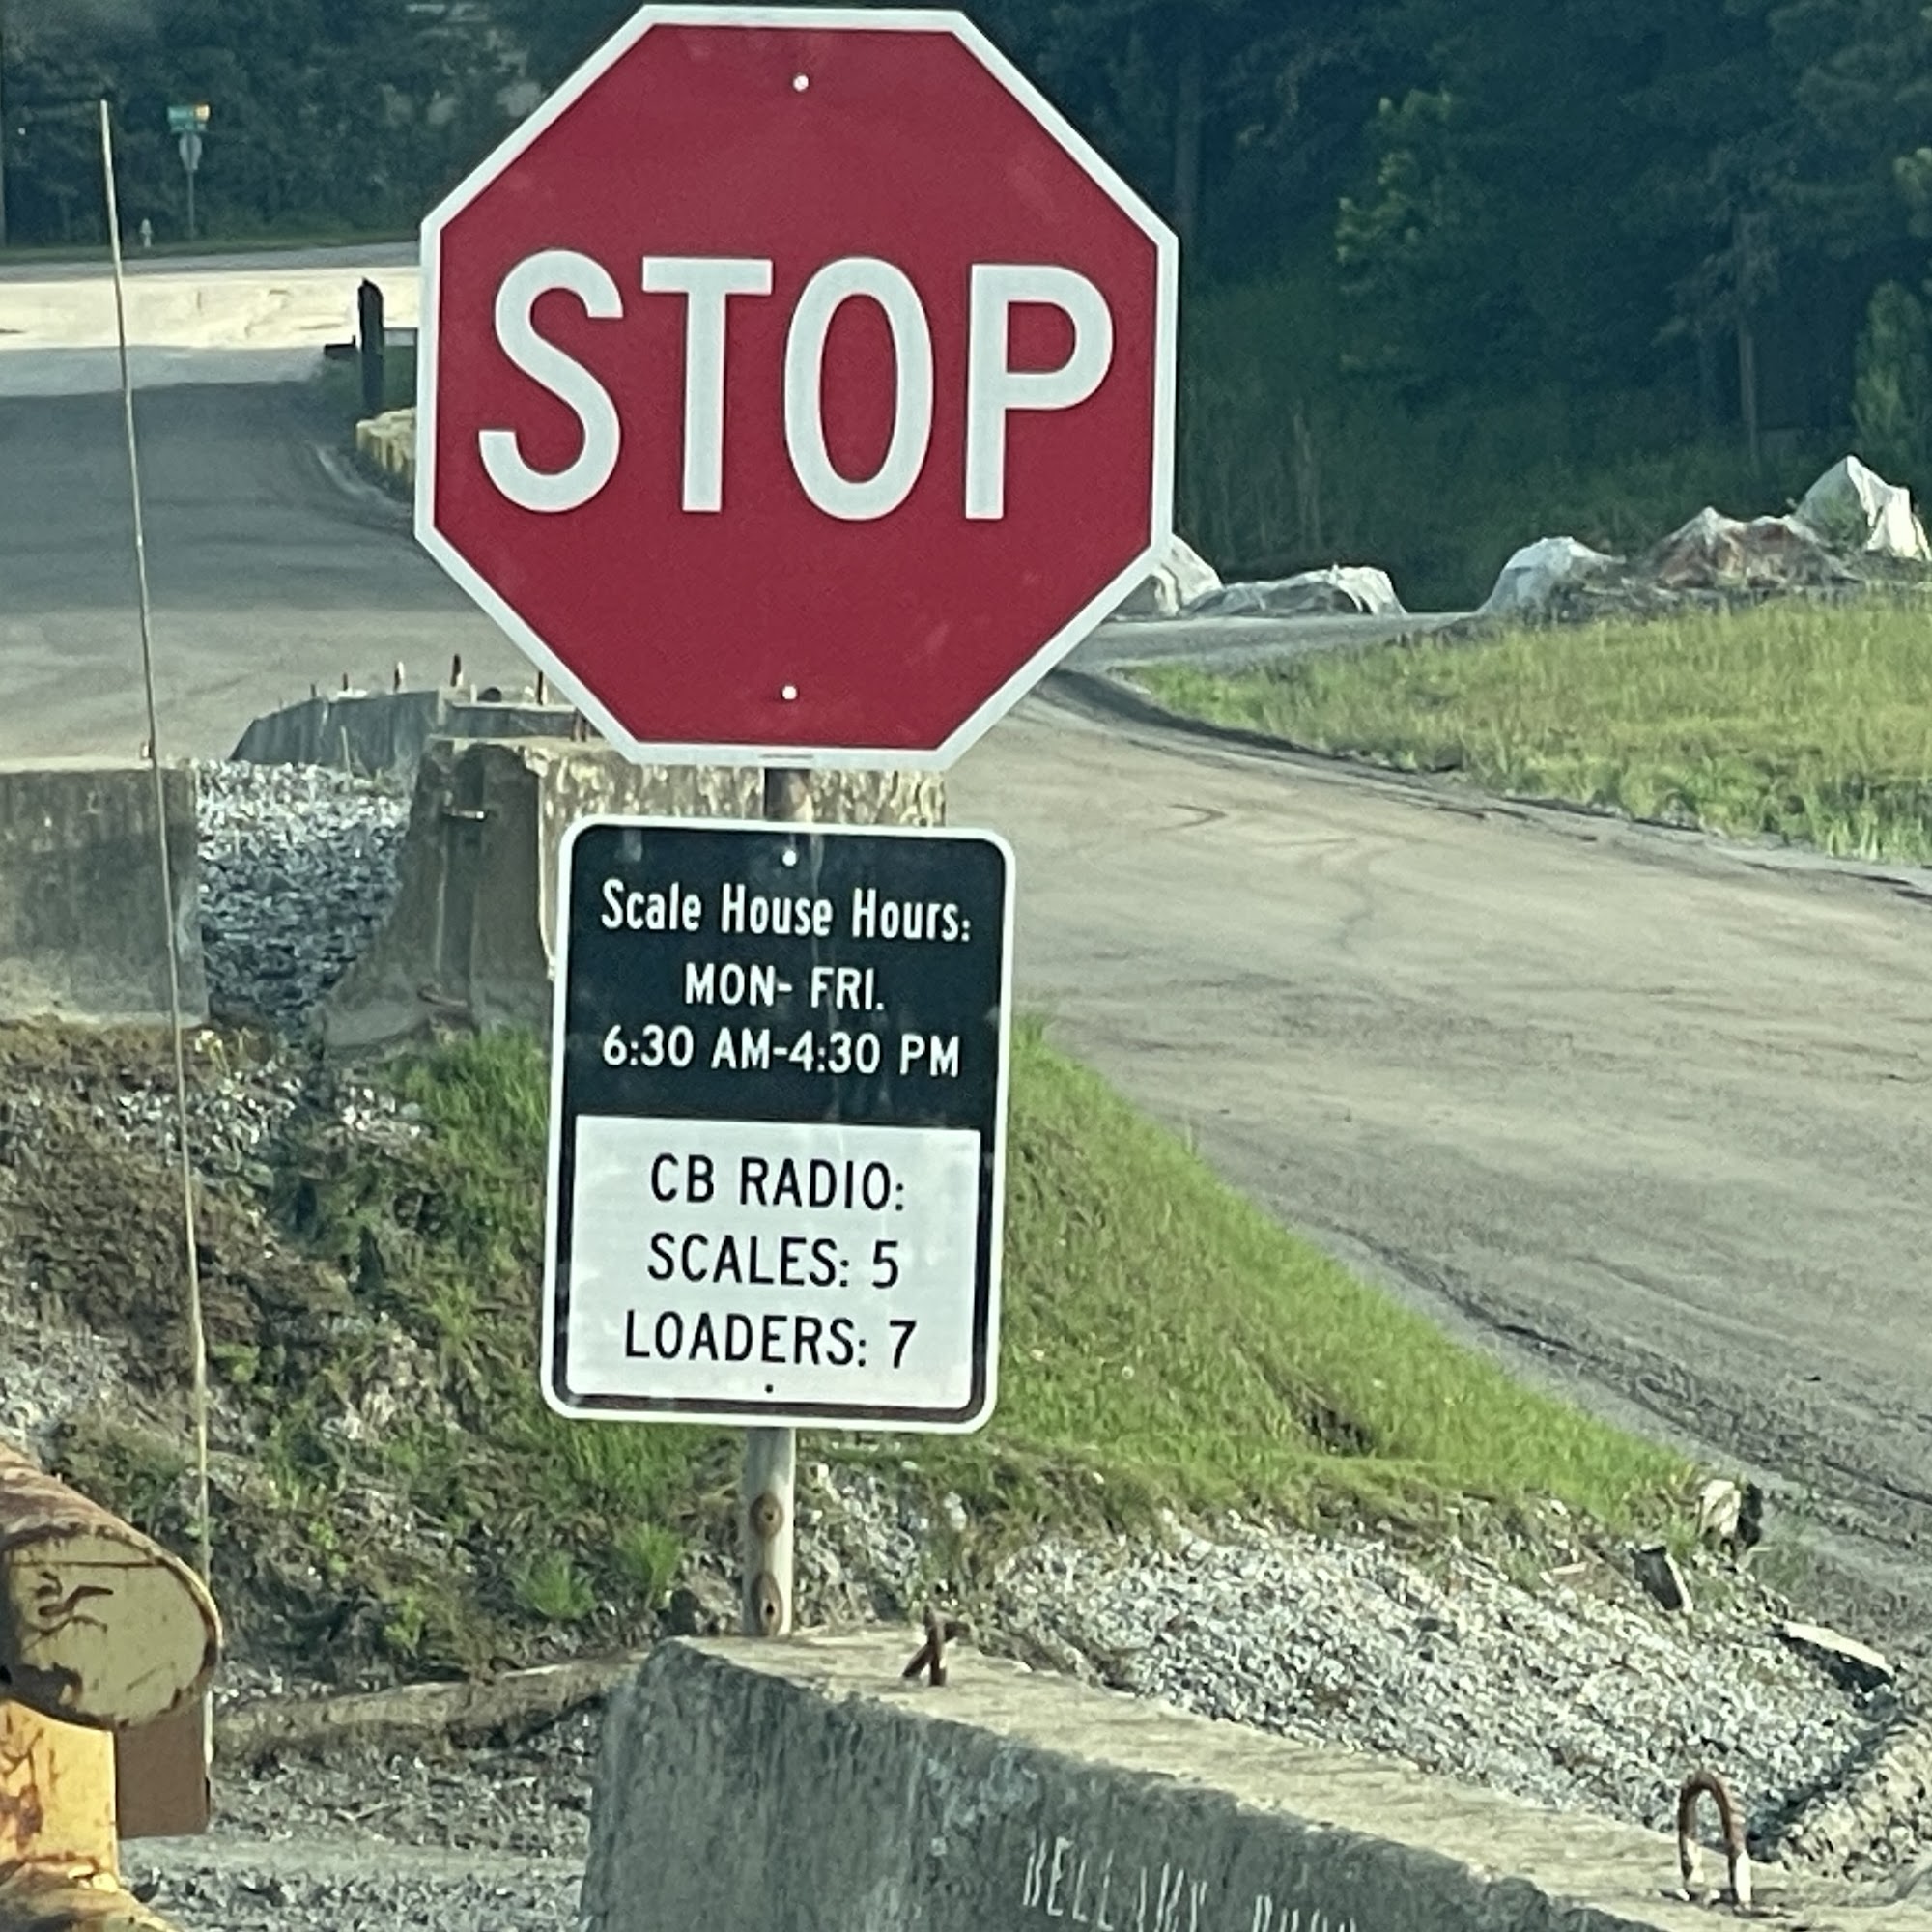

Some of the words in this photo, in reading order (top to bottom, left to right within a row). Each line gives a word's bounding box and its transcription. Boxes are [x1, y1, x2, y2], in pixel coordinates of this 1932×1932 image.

[477, 249, 1113, 521] STOP
[600, 878, 702, 931] Scale
[721, 882, 833, 937] House
[851, 887, 972, 942] Hours:
[684, 961, 793, 1007] MON-
[810, 965, 885, 1011] FRI.
[602, 1024, 694, 1067] 6:30
[710, 1026, 880, 1074] AM-4:30
[899, 1033, 960, 1078] PM
[650, 1152, 715, 1204] CB
[739, 1155, 905, 1211] RADIO:
[646, 1232, 849, 1288] SCALES:
[871, 1239, 899, 1290] 5
[624, 1309, 867, 1368] LOADERS:
[888, 1319, 918, 1369] 7
